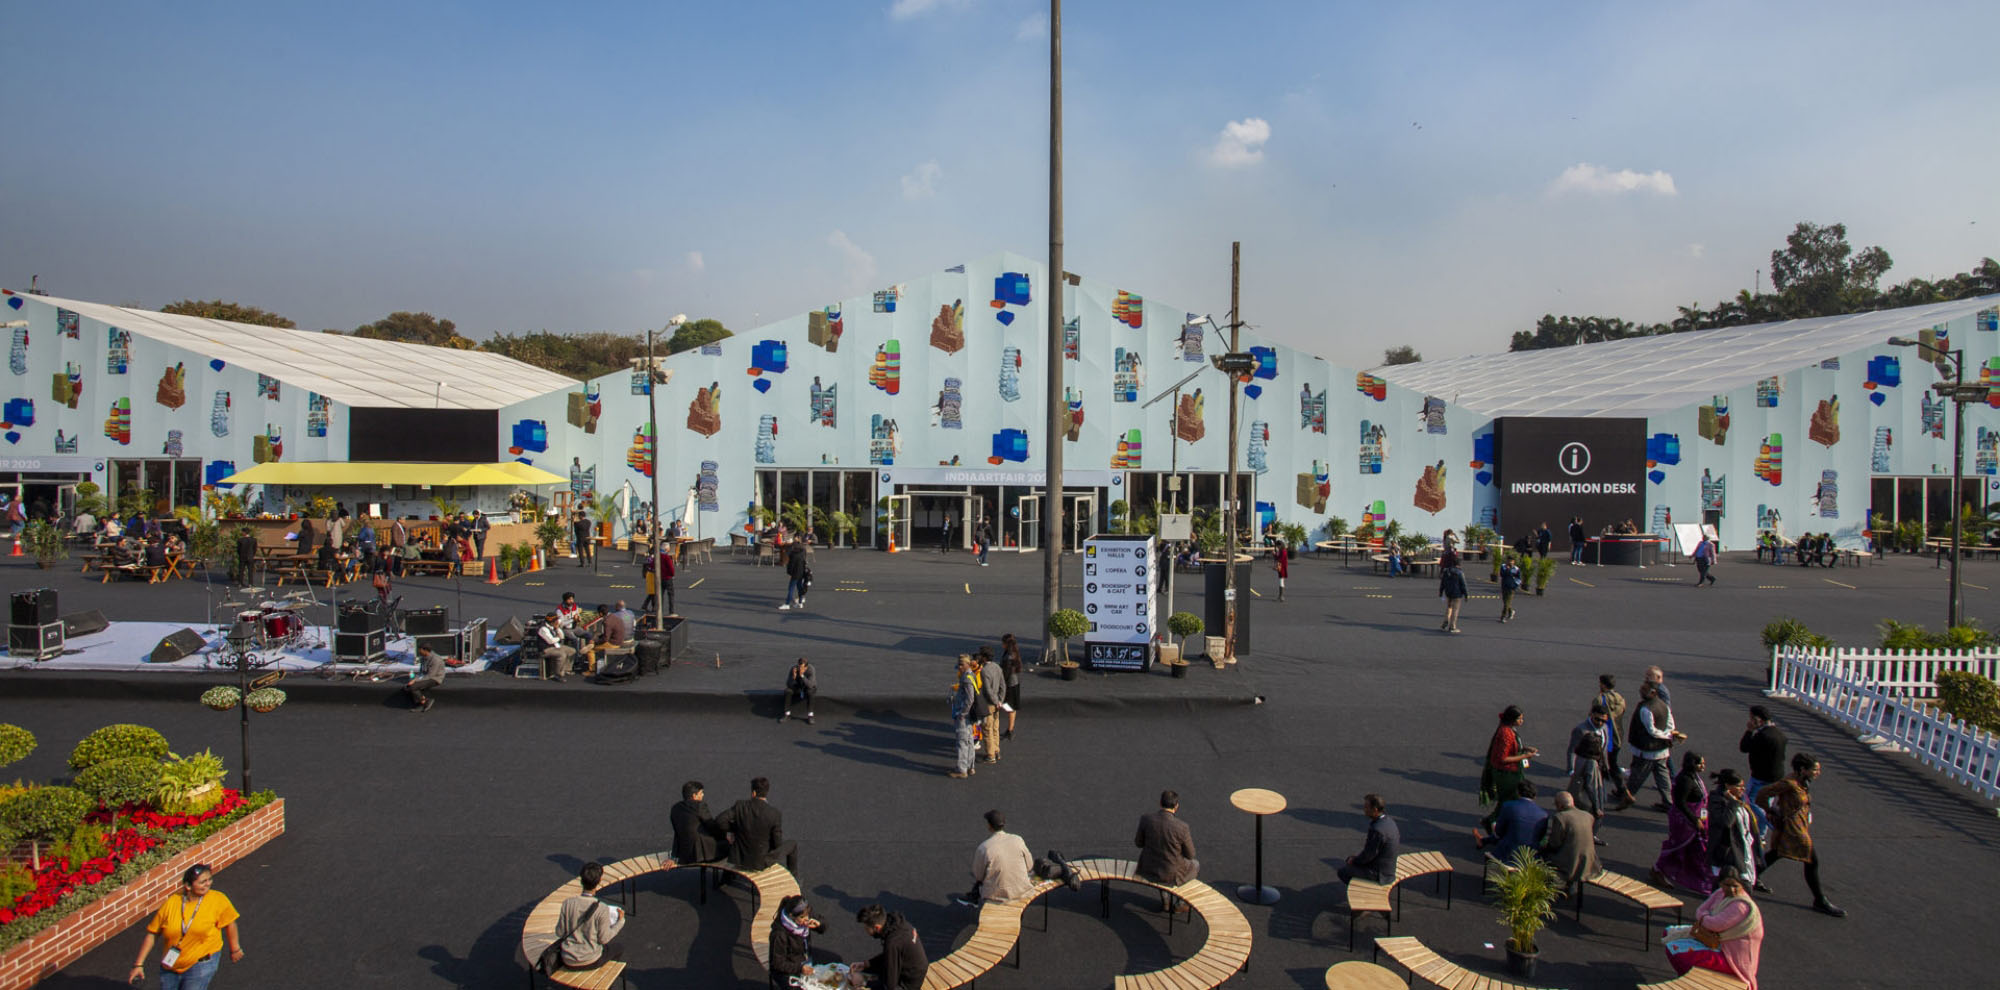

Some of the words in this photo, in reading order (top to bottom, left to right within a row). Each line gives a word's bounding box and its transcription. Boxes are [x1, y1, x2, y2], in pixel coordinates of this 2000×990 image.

[11, 460, 41, 469] 2020
[945, 472, 1026, 483] INDIAARTFAIR
[1027, 473, 1047, 483] 202
[1511, 482, 1601, 494] INFORMATION
[1603, 482, 1636, 494] DESK
